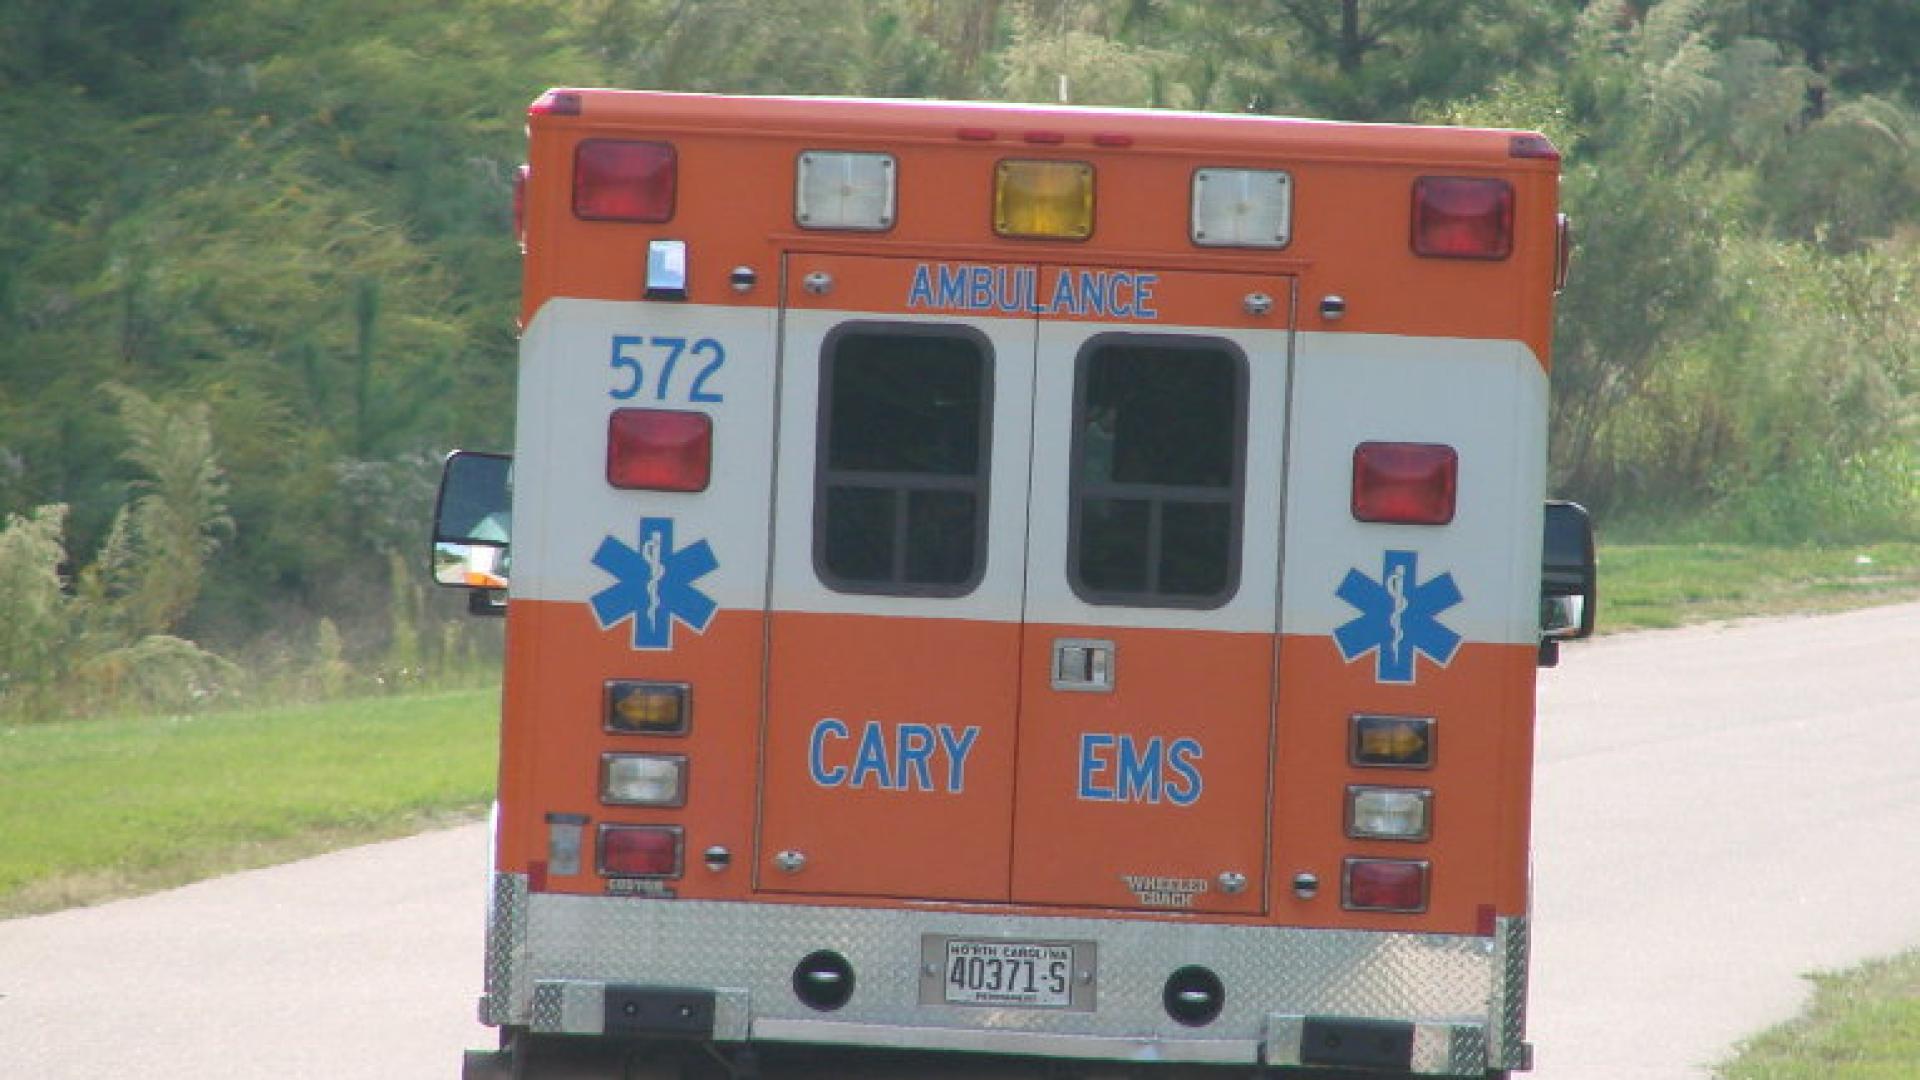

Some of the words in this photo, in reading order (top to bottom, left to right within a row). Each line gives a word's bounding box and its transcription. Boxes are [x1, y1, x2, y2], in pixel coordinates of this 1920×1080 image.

[910, 264, 1158, 319] AMBULANCE
[609, 336, 725, 402] 572
[808, 718, 981, 792] CARY
[1078, 732, 1203, 805] EMS
[950, 945, 997, 956] NORTH
[950, 957, 1066, 993] 40371-S
